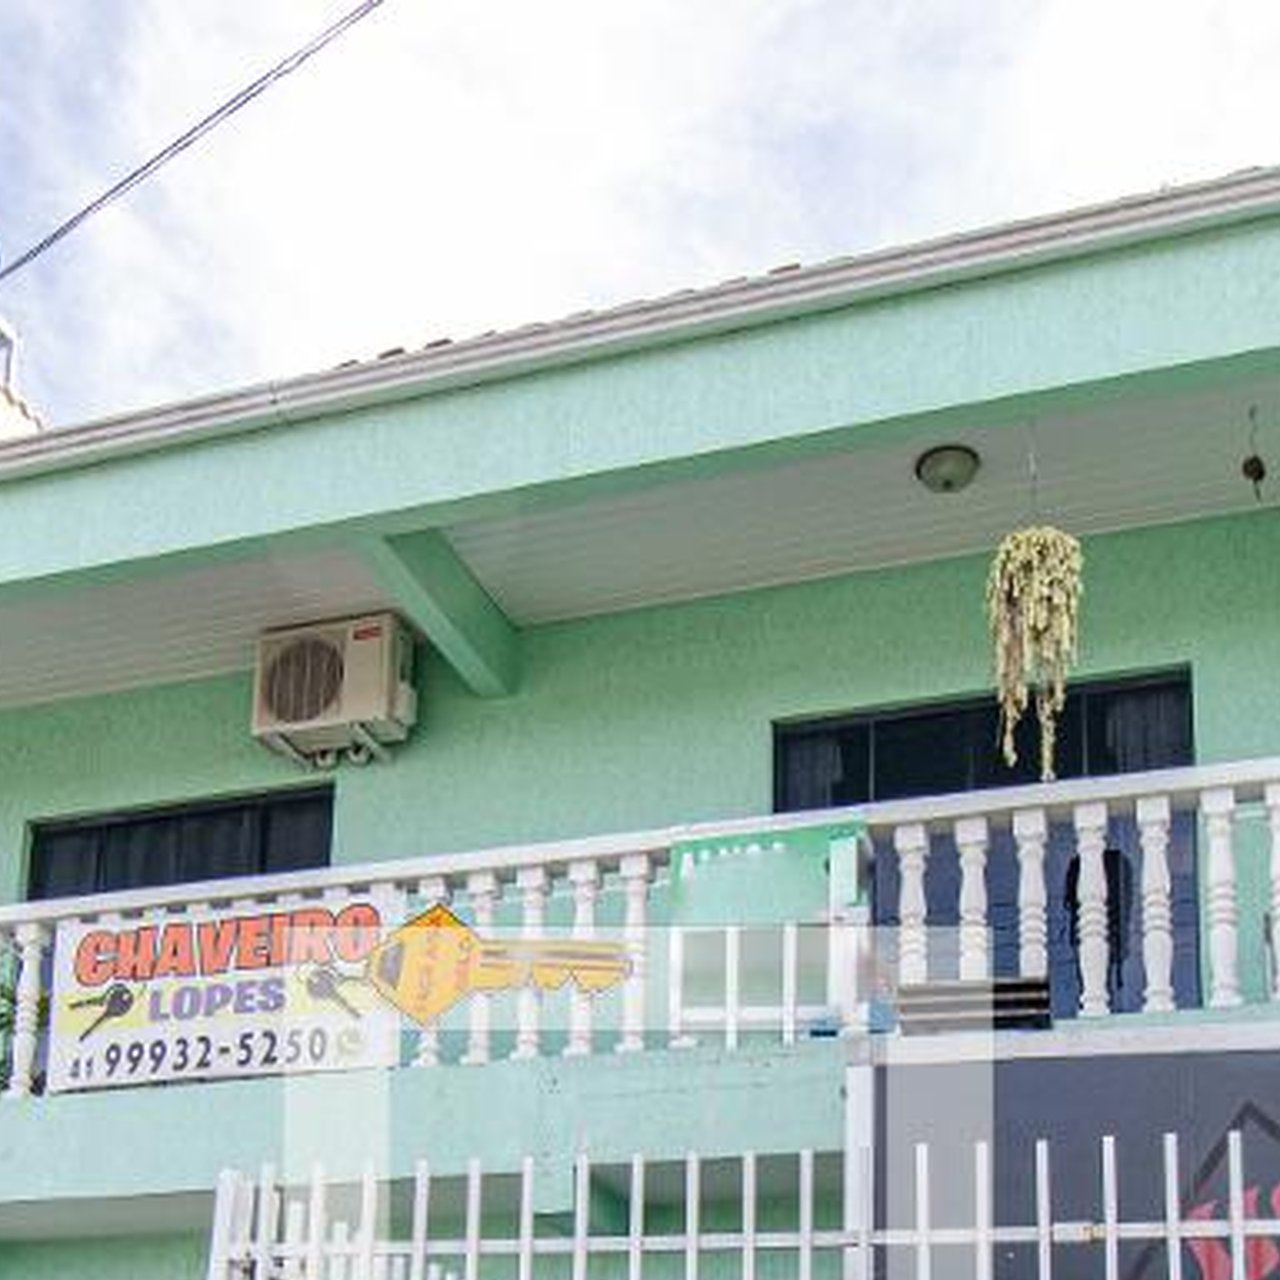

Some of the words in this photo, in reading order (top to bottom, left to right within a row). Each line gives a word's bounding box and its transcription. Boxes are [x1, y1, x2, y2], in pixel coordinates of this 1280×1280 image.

[74, 903, 381, 987] CHAVEIRO
[147, 977, 287, 1022] LOPES
[104, 1027, 327, 1078] 99932-5250
